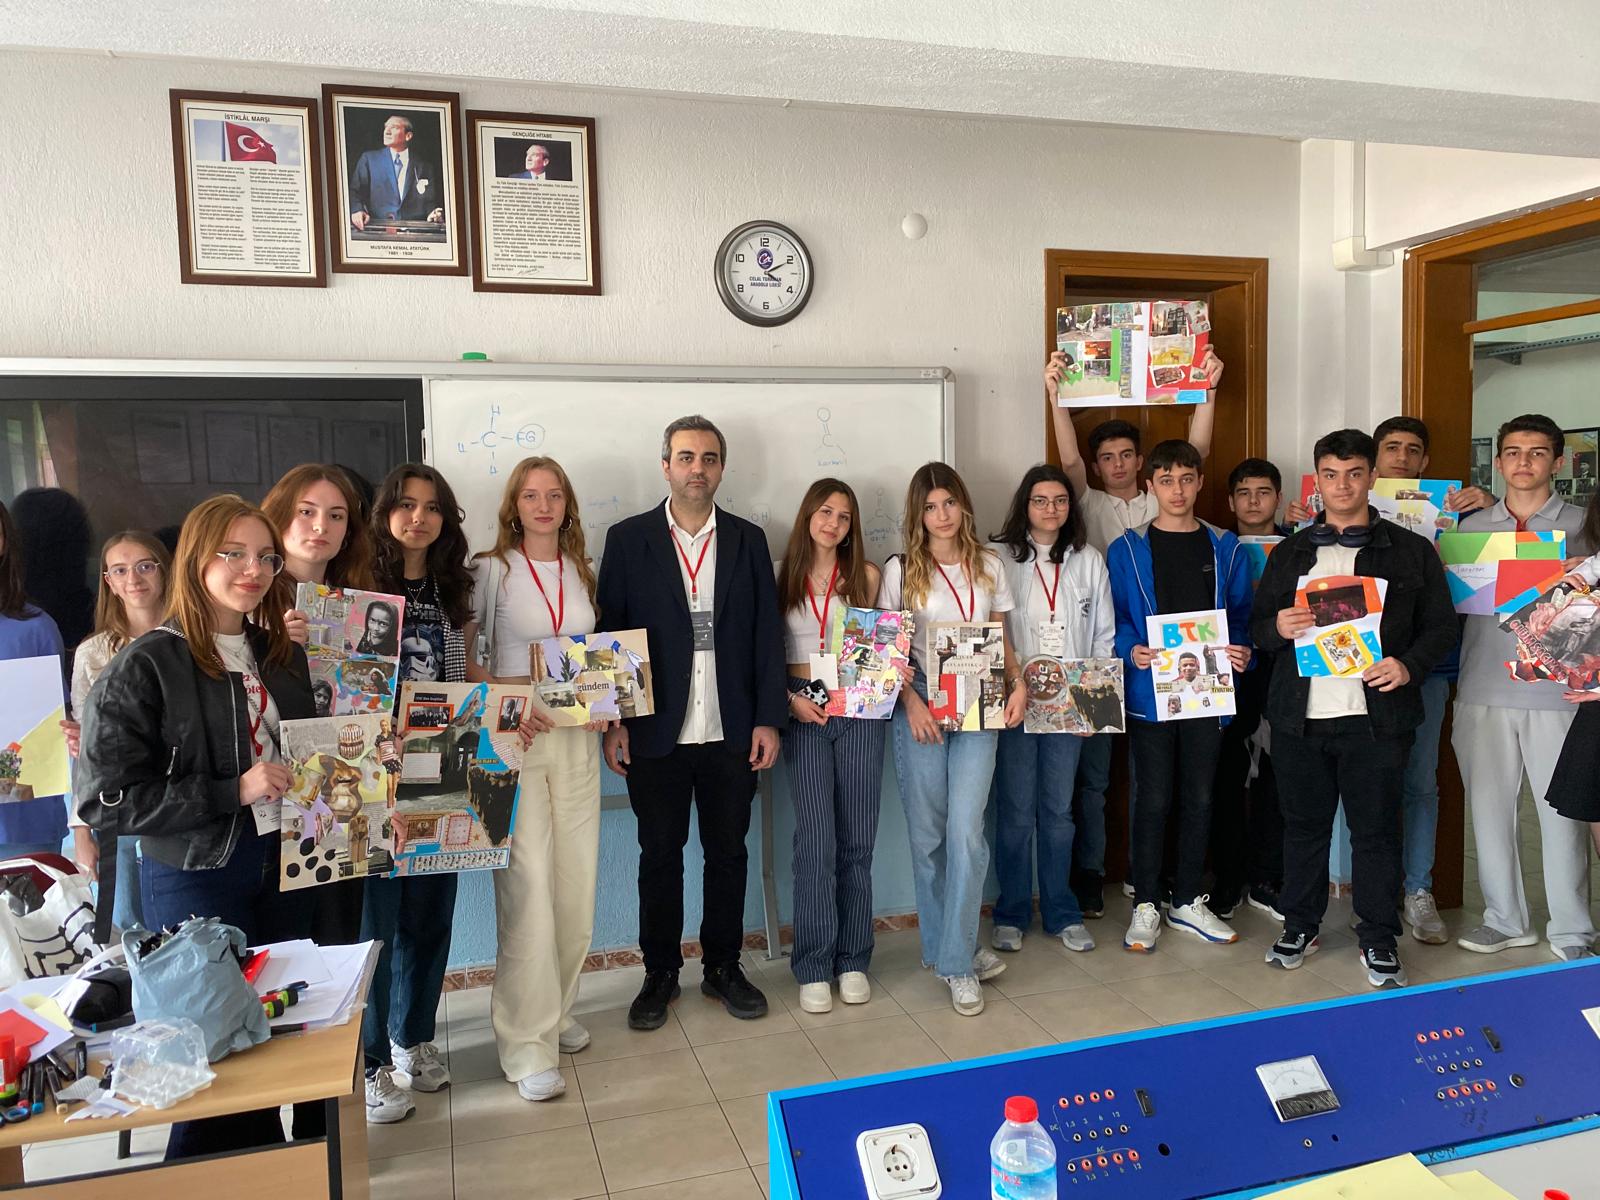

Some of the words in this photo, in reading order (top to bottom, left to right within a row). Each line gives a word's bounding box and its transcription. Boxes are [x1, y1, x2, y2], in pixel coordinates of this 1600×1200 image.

[760, 238, 769, 247] 12
[736, 254, 744, 262] 10
[786, 255, 793, 264] 2
[737, 284, 744, 292] 8
[1162, 622, 1216, 648] BTK
[577, 682, 610, 692] gündem
